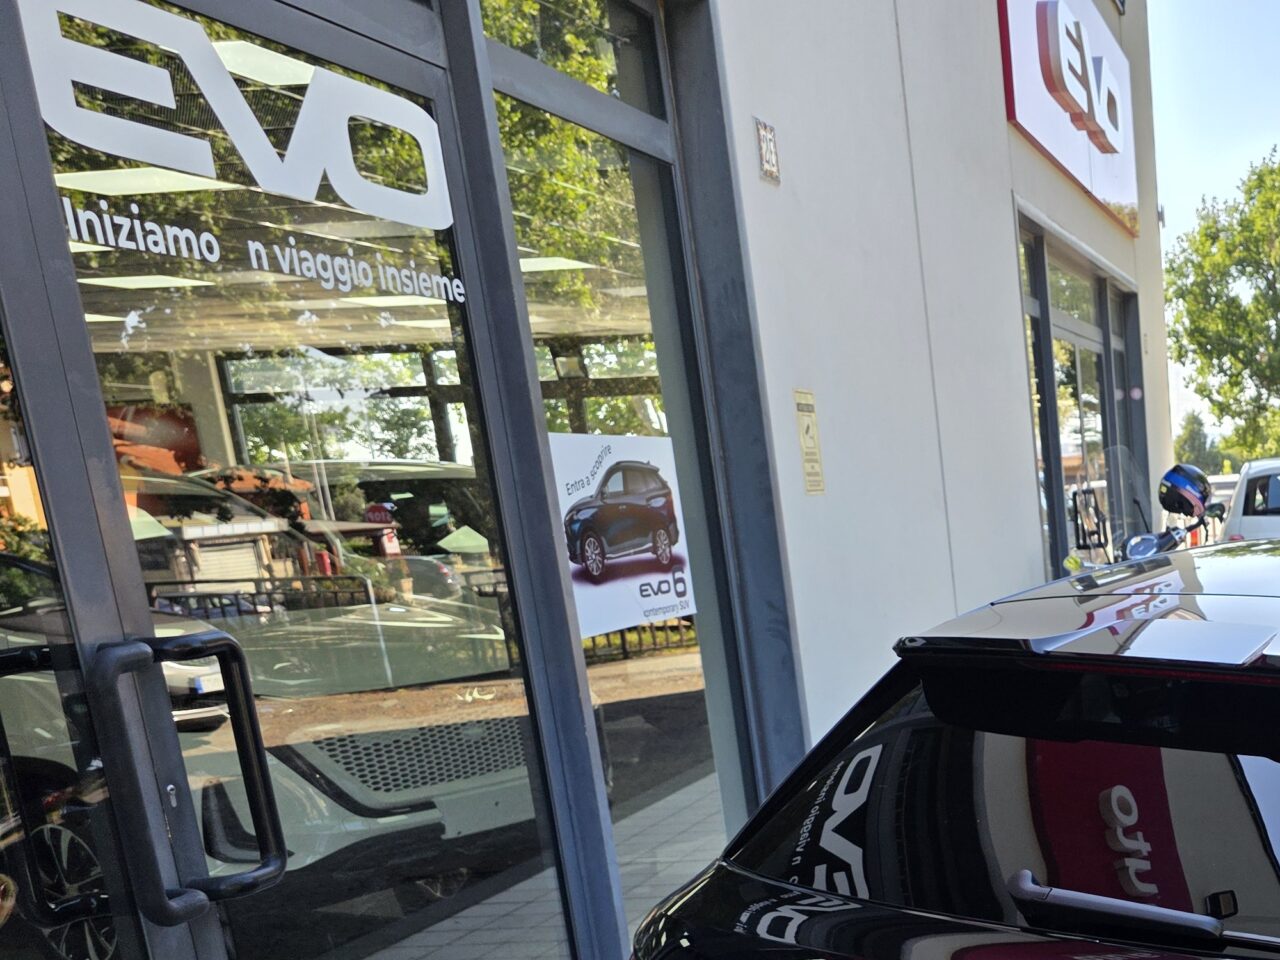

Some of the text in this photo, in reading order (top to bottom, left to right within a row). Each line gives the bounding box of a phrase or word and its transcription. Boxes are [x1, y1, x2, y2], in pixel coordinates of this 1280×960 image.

[17, 0, 454, 230] EVO
[62, 196, 221, 263] Iniziamo
[273, 236, 373, 293] viaggio
[378, 252, 467, 304] insieme
[565, 444, 612, 497] Entra a scoprire
[639, 566, 688, 599] EVO 6
